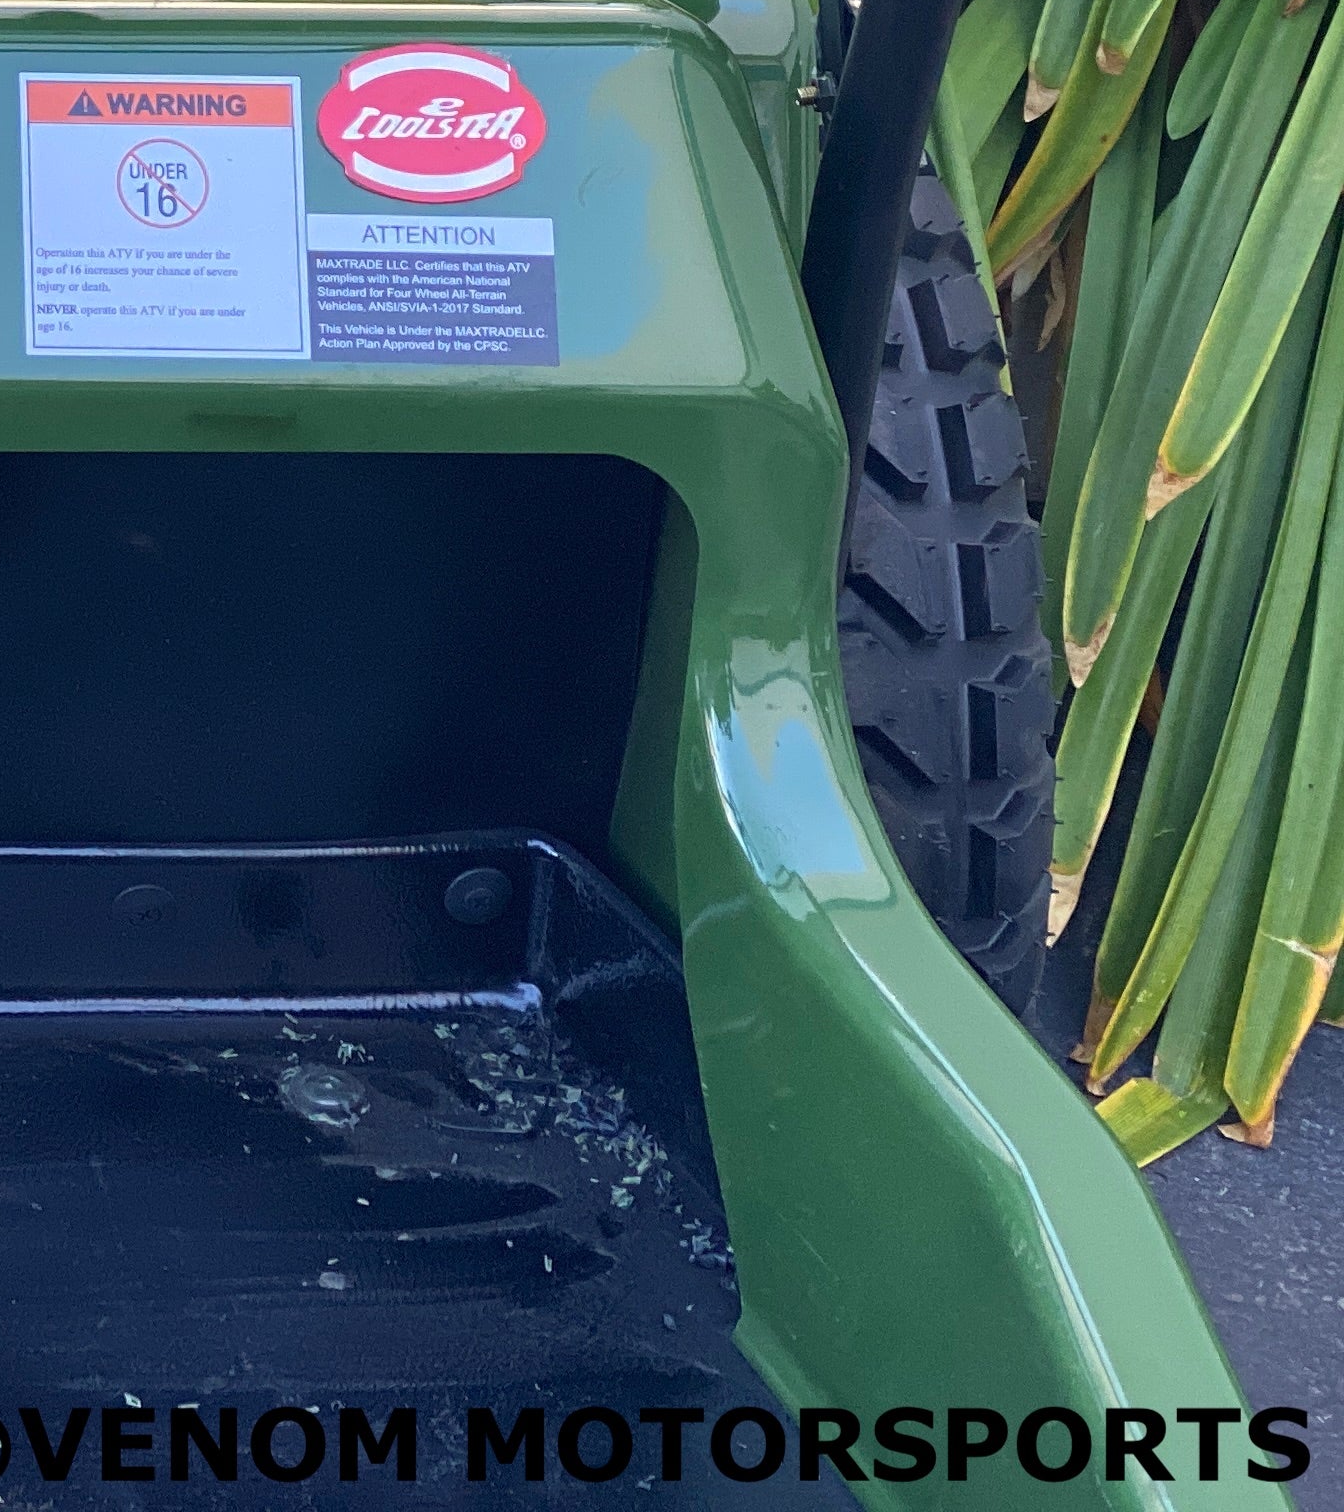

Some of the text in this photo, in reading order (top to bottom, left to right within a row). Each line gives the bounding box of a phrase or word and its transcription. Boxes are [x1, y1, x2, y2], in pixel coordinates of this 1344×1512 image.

[106, 92, 247, 117] WARNING
[129, 163, 188, 180] UNDER
[136, 182, 178, 217] 16
[361, 224, 496, 246] ATTENTION
[36, 248, 84, 259] Operation
[87, 248, 105, 258] this
[108, 248, 133, 259] ATV
[146, 251, 164, 260] you
[167, 251, 183, 259] are
[185, 250, 213, 259] under
[216, 250, 231, 260] the
[36, 264, 238, 277] age of 16 increases your chance of severe
[316, 258, 383, 269] MAXTRADE
[414, 260, 459, 271] Certifies
[462, 261, 483, 271] that
[486, 262, 505, 272] this
[507, 262, 530, 273] ATV
[316, 273, 511, 286] complies with the American National
[37, 281, 111, 293] injury or death.
[317, 286, 507, 300] Standard for Four Wheel All-Terrain
[37, 304, 79, 314] NEVER
[81, 306, 117, 317] operate
[119, 305, 137, 315] this
[140, 305, 165, 315] ATV
[178, 308, 196, 318] you
[200, 308, 215, 316] are
[218, 306, 246, 317] under
[368, 301, 469, 313] ANSI/SVIA-1-2017
[472, 303, 525, 315] Standard.
[37, 321, 73, 333] age 16.
[318, 323, 342, 334] This
[344, 324, 384, 335] Vehicle
[387, 324, 396, 335] is
[399, 325, 432, 336] Under
[435, 326, 452, 336] the
[319, 337, 353, 348] Action
[356, 338, 380, 349] Plan
[383, 338, 435, 351] Approved
[438, 340, 451, 352] by
[454, 340, 471, 351] the
